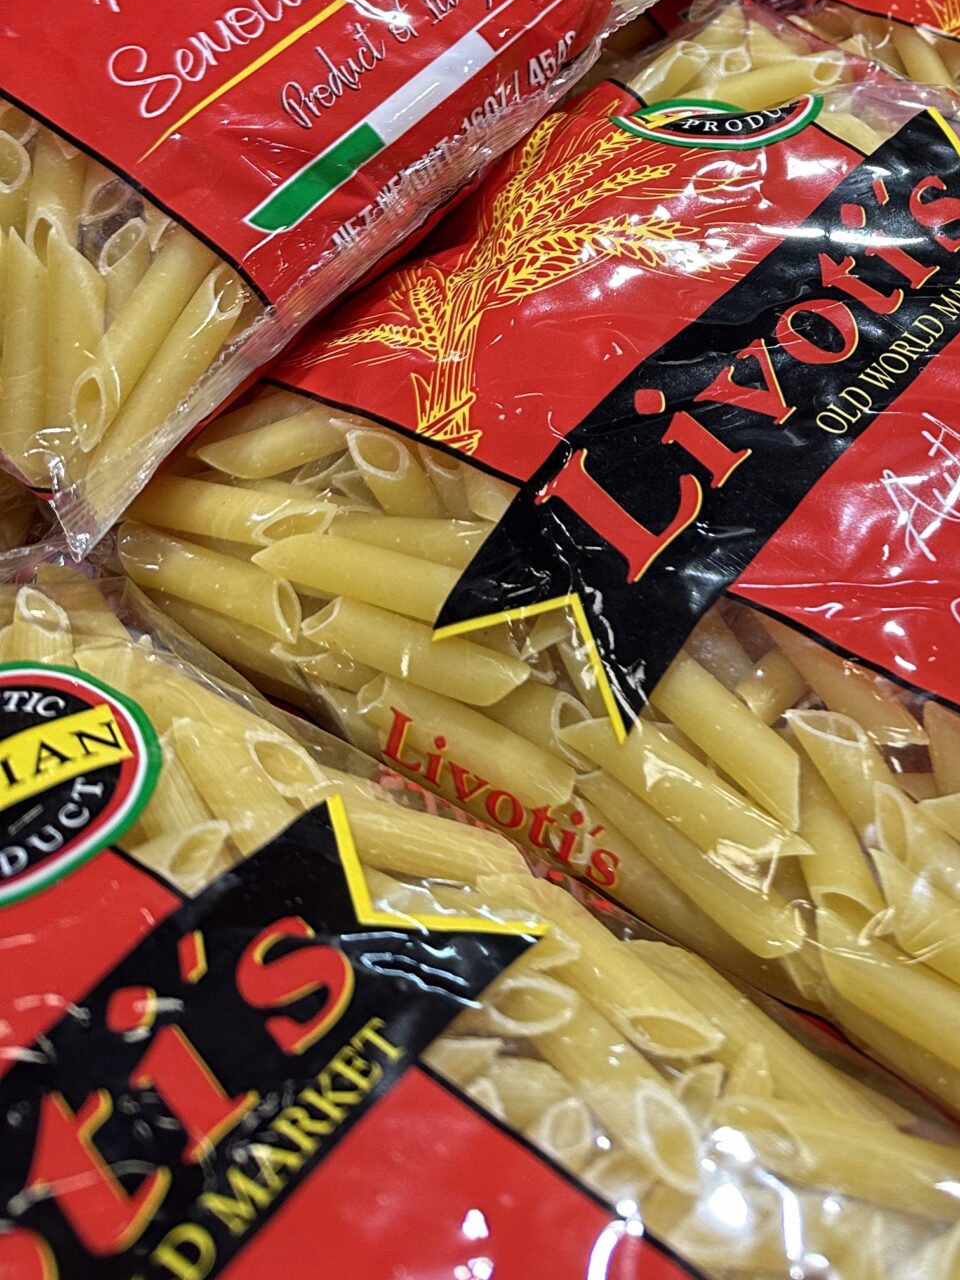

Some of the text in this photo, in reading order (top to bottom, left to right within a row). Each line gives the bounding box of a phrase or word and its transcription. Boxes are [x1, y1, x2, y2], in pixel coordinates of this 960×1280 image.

[281, 23, 386, 130] Product
[816, 386, 873, 435] OLD
[858, 314, 945, 391] WORLD
[381, 706, 622, 889] Livoti's
[200, 1017, 405, 1236] MARKET
